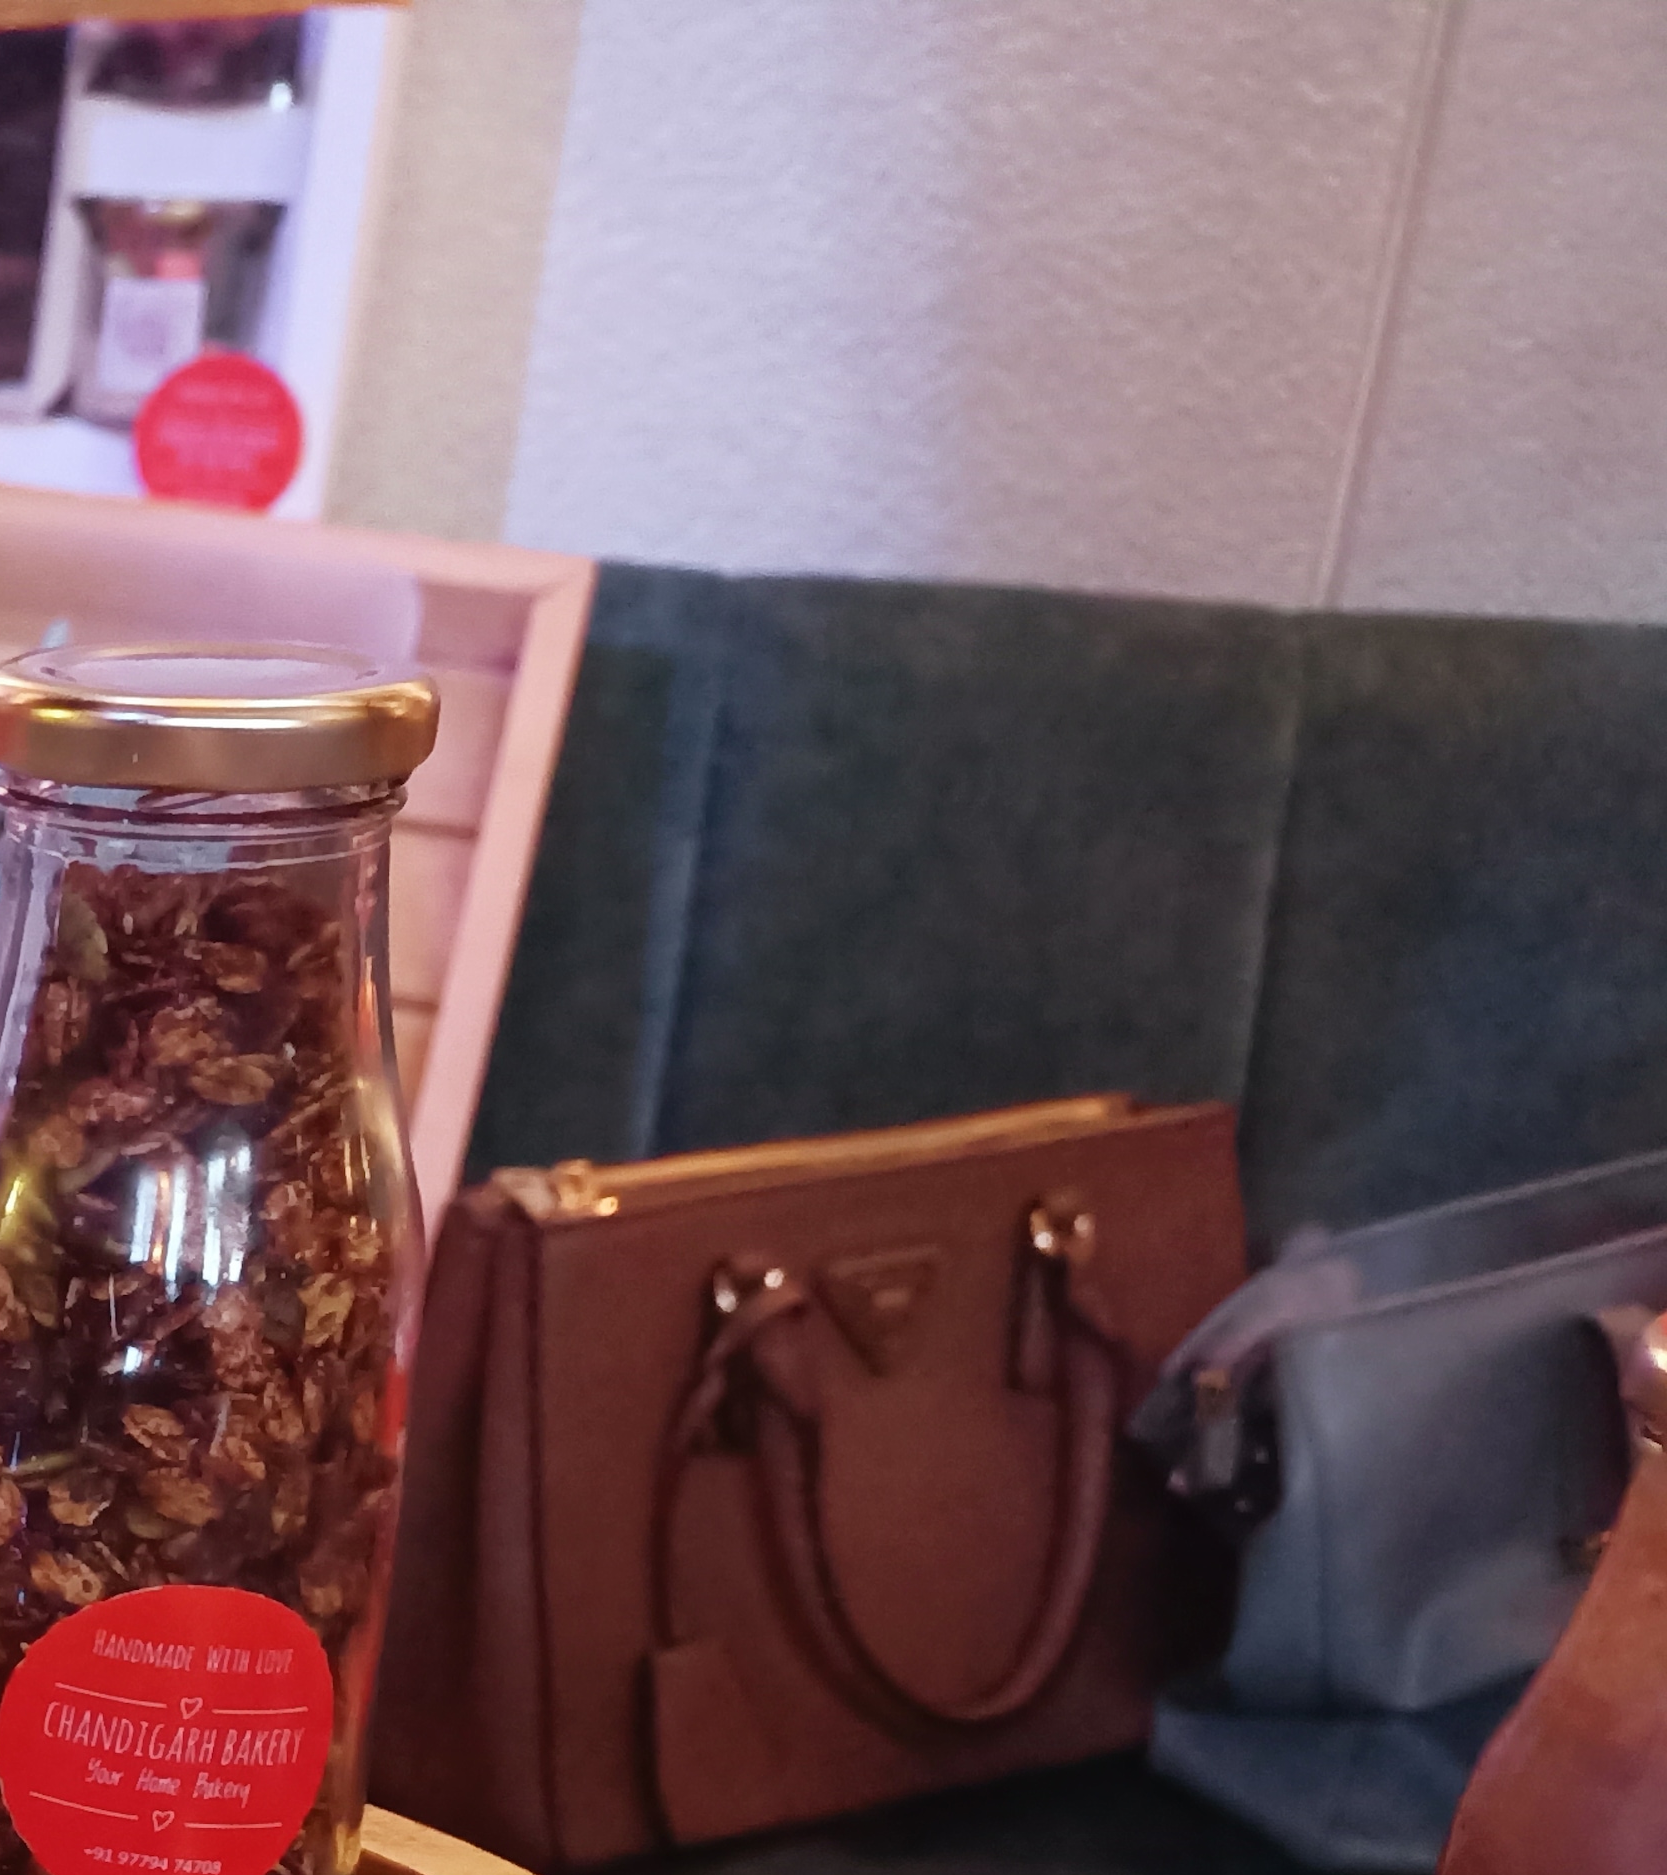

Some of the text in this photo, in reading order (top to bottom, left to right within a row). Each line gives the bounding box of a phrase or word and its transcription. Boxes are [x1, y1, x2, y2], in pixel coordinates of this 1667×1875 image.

[93, 1628, 294, 1675] HANDMADE WITH LOVE
[43, 1700, 305, 1767] CHANDIGARH BAKERY
[85, 1757, 250, 1808] Your Home Bakery
[117, 1850, 168, 1872] 97794
[173, 1858, 222, 1875] 74708
